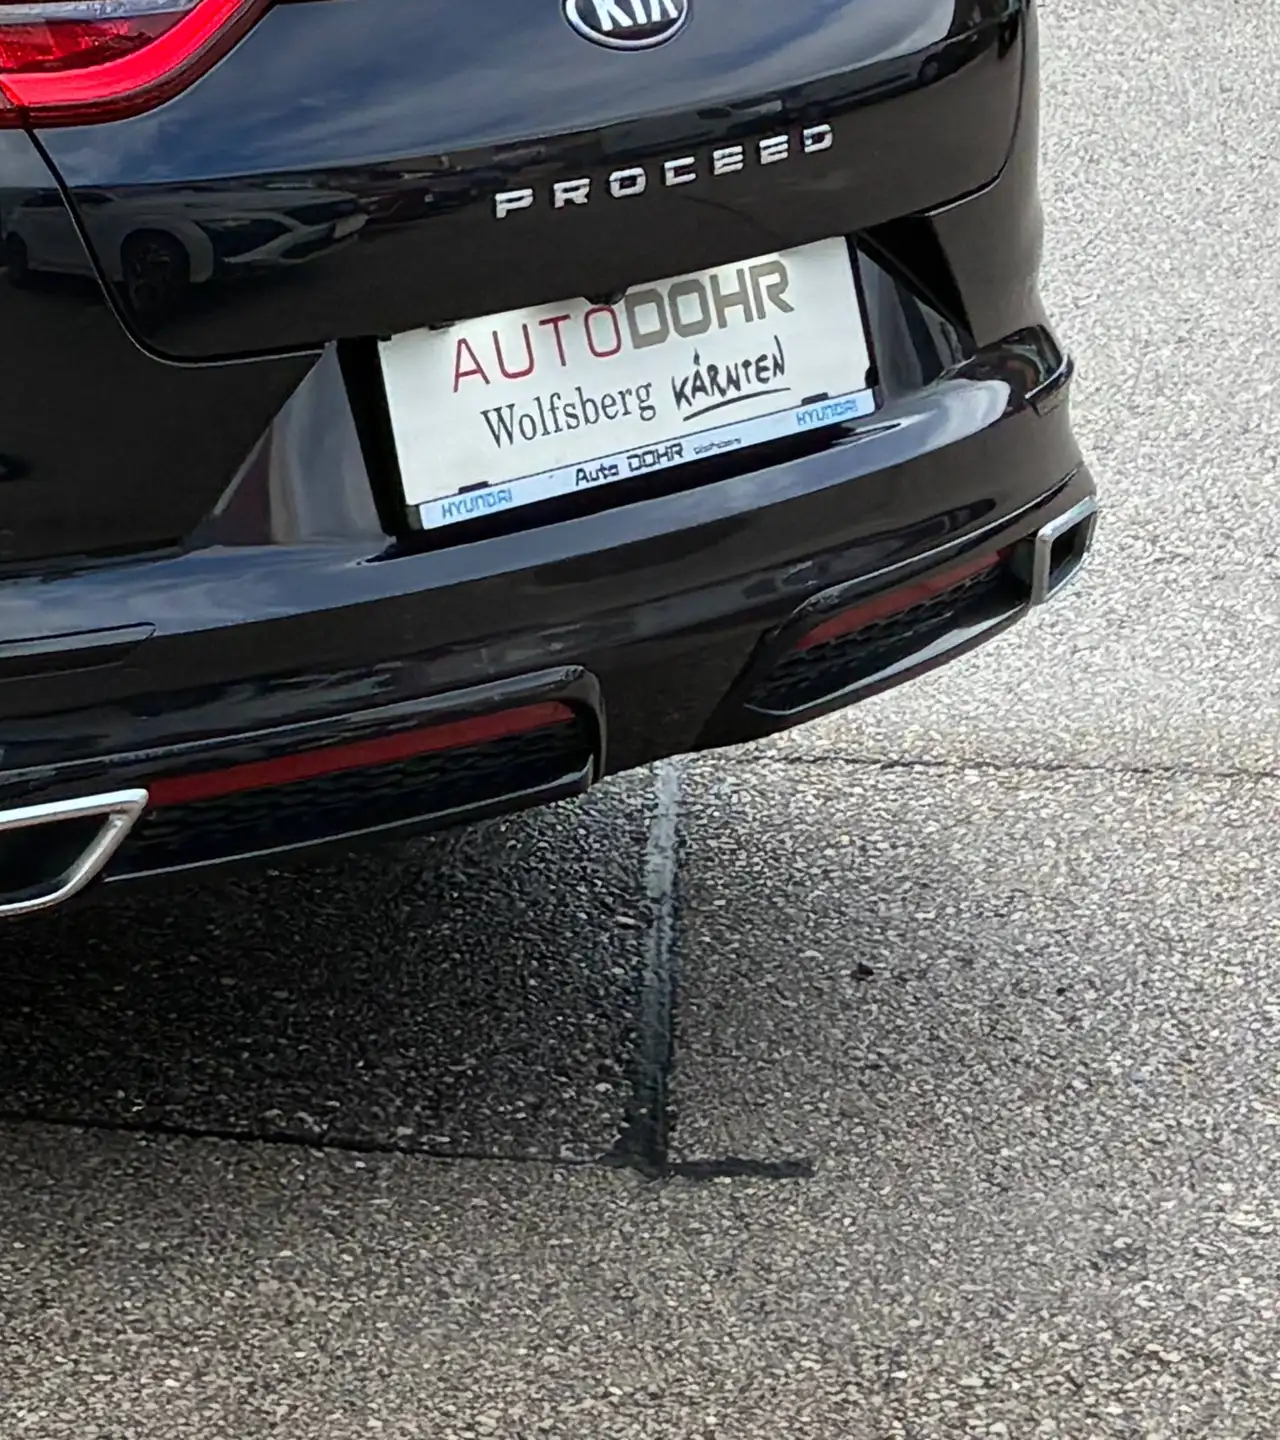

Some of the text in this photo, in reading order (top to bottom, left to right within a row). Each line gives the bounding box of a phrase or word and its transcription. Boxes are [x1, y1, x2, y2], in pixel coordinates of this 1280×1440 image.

[495, 123, 834, 219] PROCEED
[453, 261, 794, 393] AUTODOHR
[480, 382, 657, 449] Wolfsberg
[441, 488, 513, 520] HYUNDAI
[575, 462, 619, 486] Auto
[627, 442, 684, 473] DOHR
